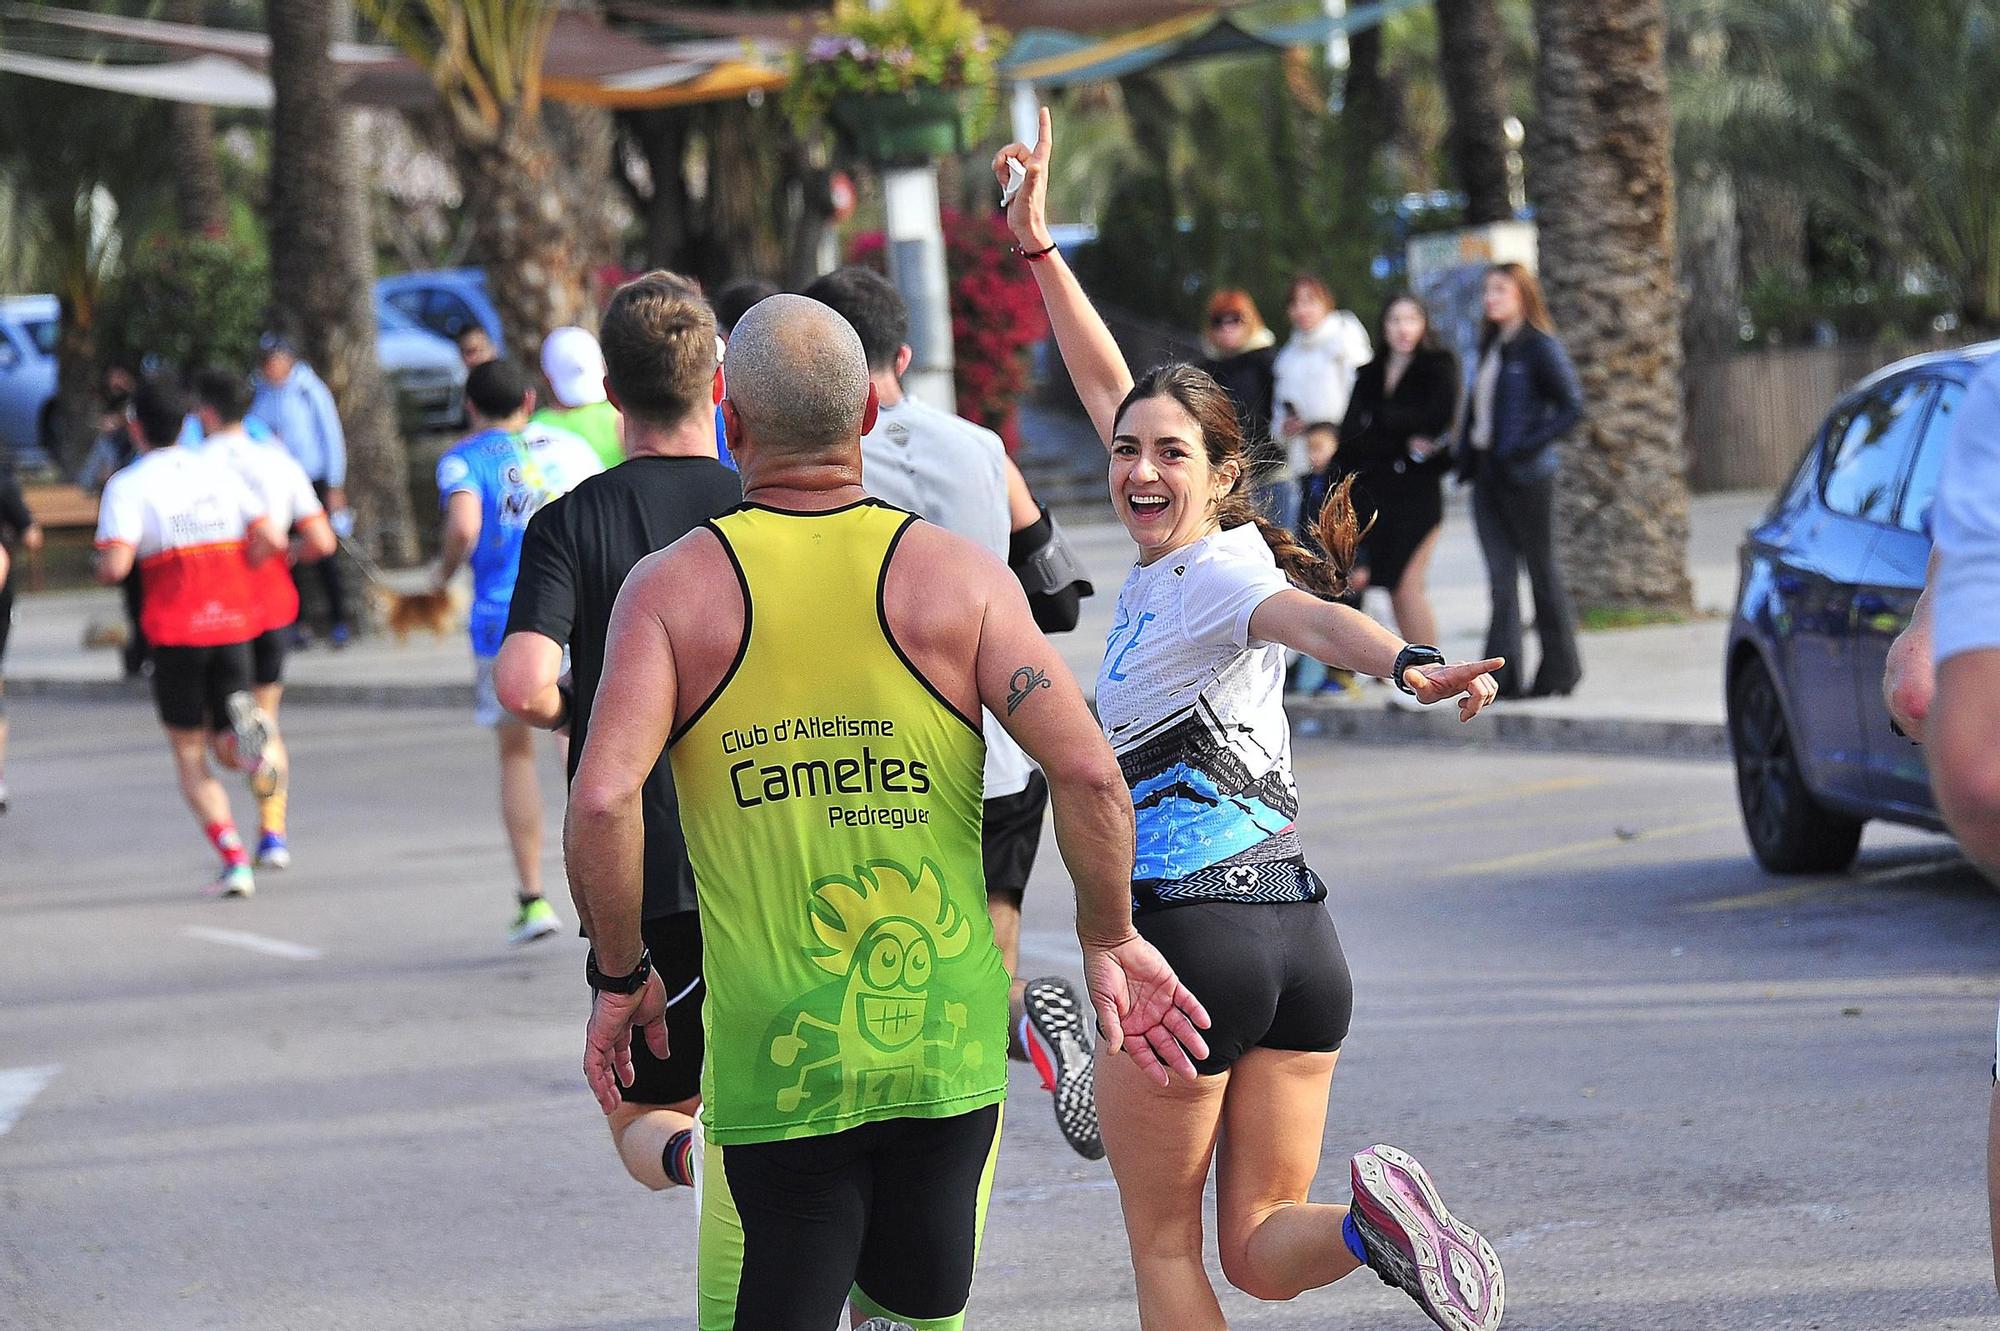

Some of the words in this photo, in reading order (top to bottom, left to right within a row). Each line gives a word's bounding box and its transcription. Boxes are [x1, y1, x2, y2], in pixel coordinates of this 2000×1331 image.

[721, 724, 768, 754] Club
[773, 715, 894, 742] d'Atletisme
[729, 746, 931, 809] Cametes
[828, 804, 930, 830] Pedreguer
